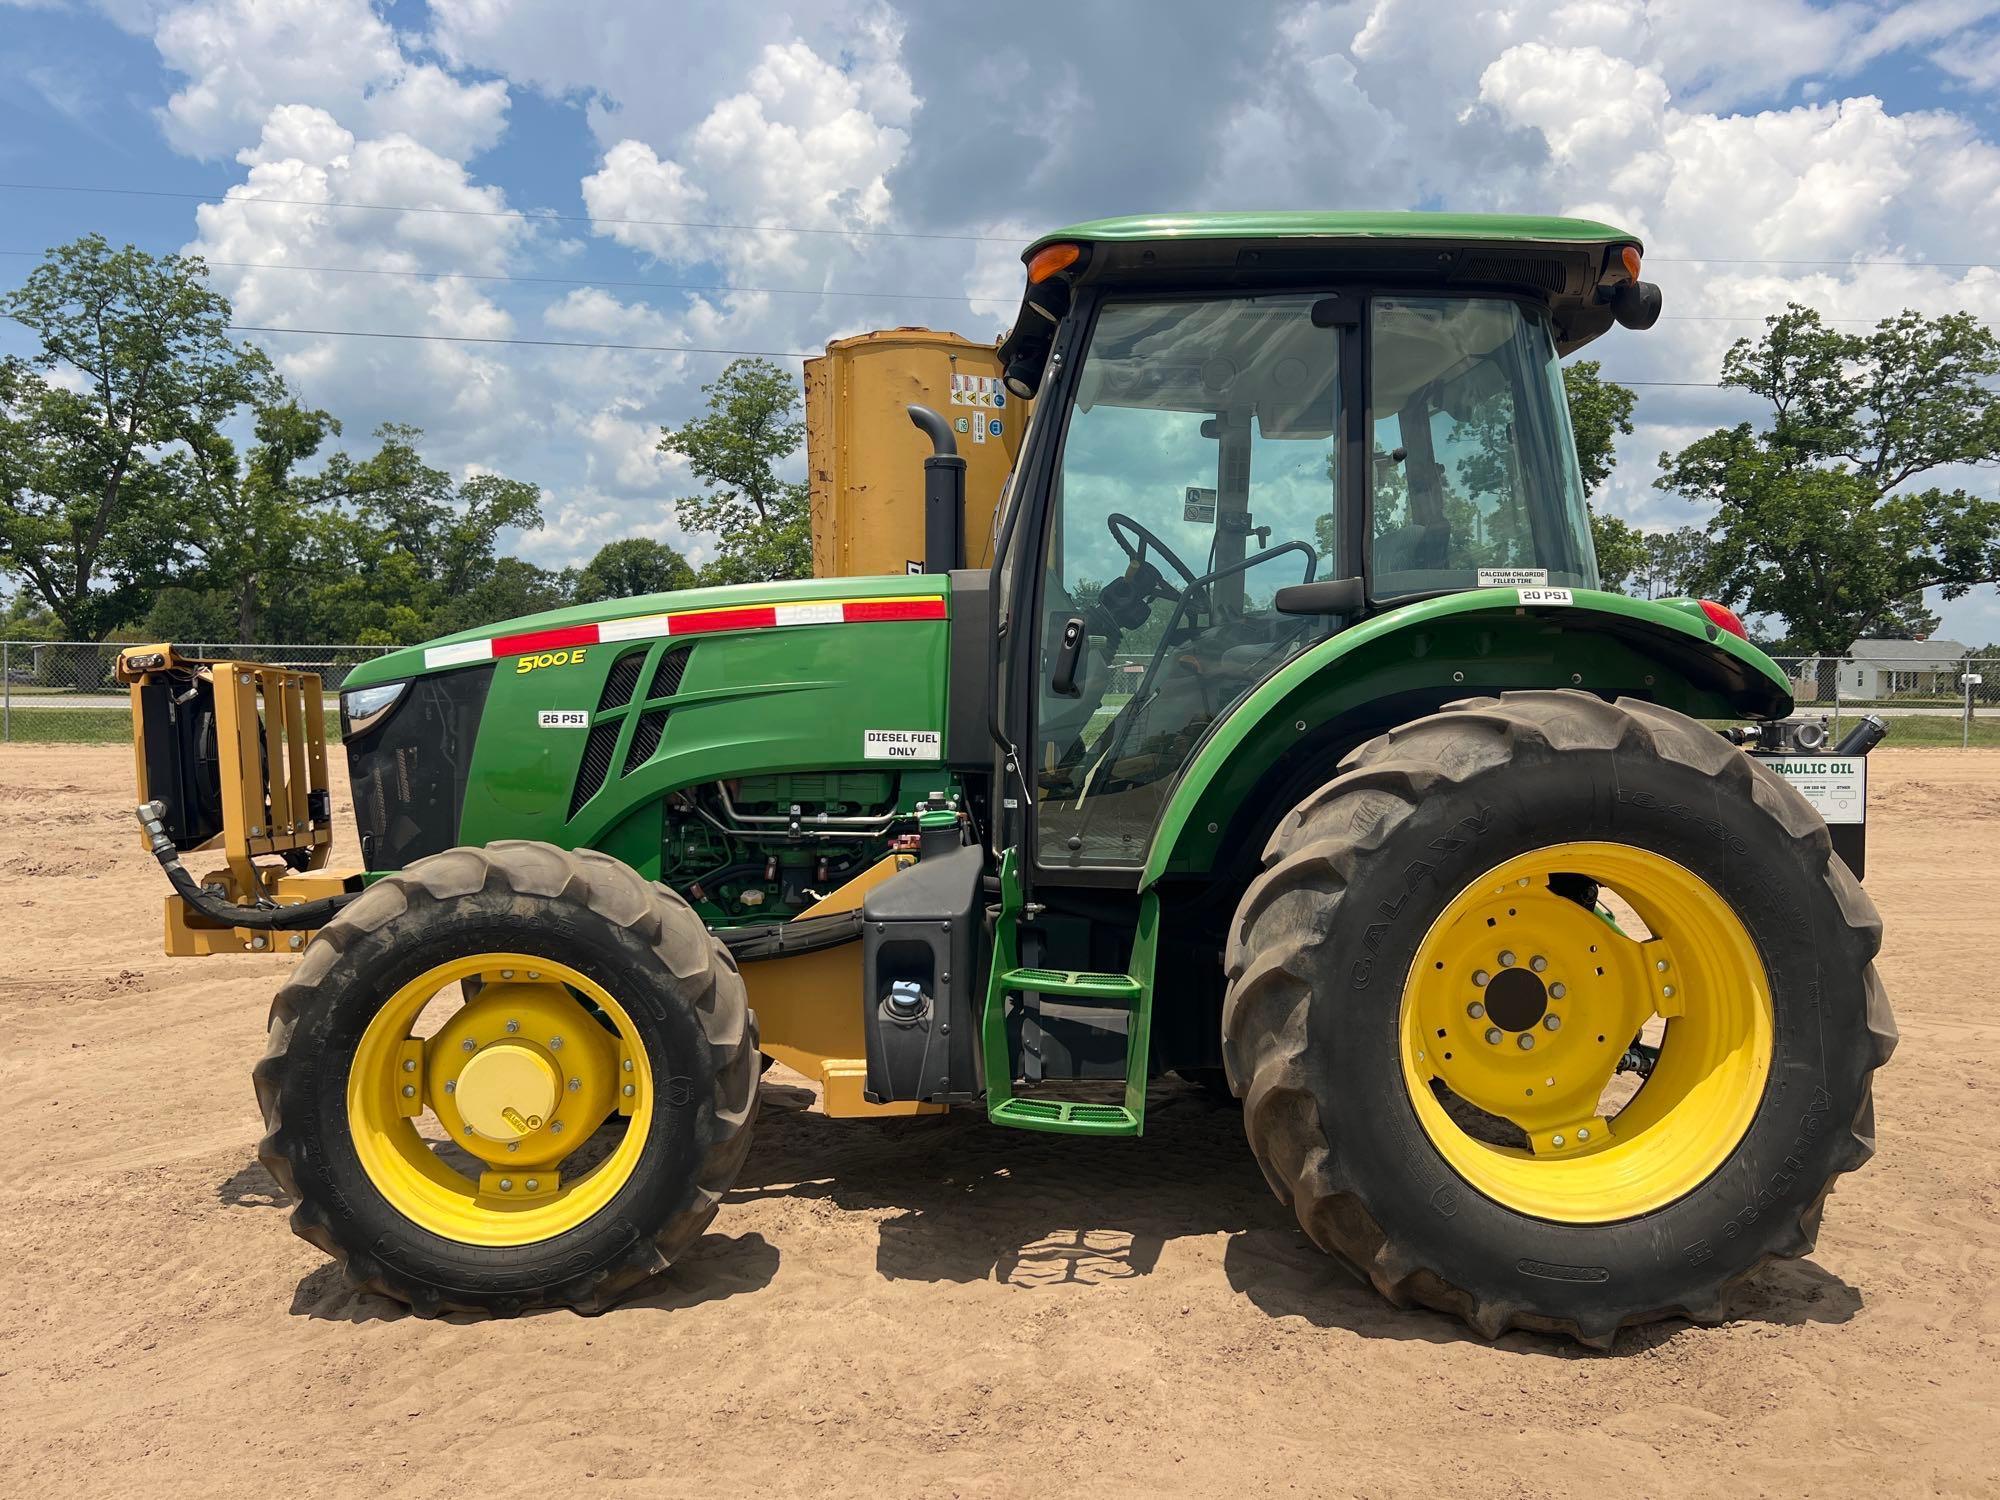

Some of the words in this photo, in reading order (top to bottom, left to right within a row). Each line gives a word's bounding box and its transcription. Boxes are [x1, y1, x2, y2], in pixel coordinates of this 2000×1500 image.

[1523, 591, 1541, 600] 20
[1544, 591, 1568, 600] PSI
[516, 651, 569, 674] 5100
[570, 649, 588, 664] E
[542, 714, 559, 724] 26
[562, 714, 584, 724] PSI
[868, 732, 909, 743] DIESEL
[911, 733, 938, 744] FUEL
[888, 746, 917, 756] ONLY
[1766, 763, 1827, 774] DRAULIC
[1830, 763, 1854, 774] OIL
[1350, 804, 1497, 991] GALAXY
[1722, 1085, 1832, 1240] AgriTrac
